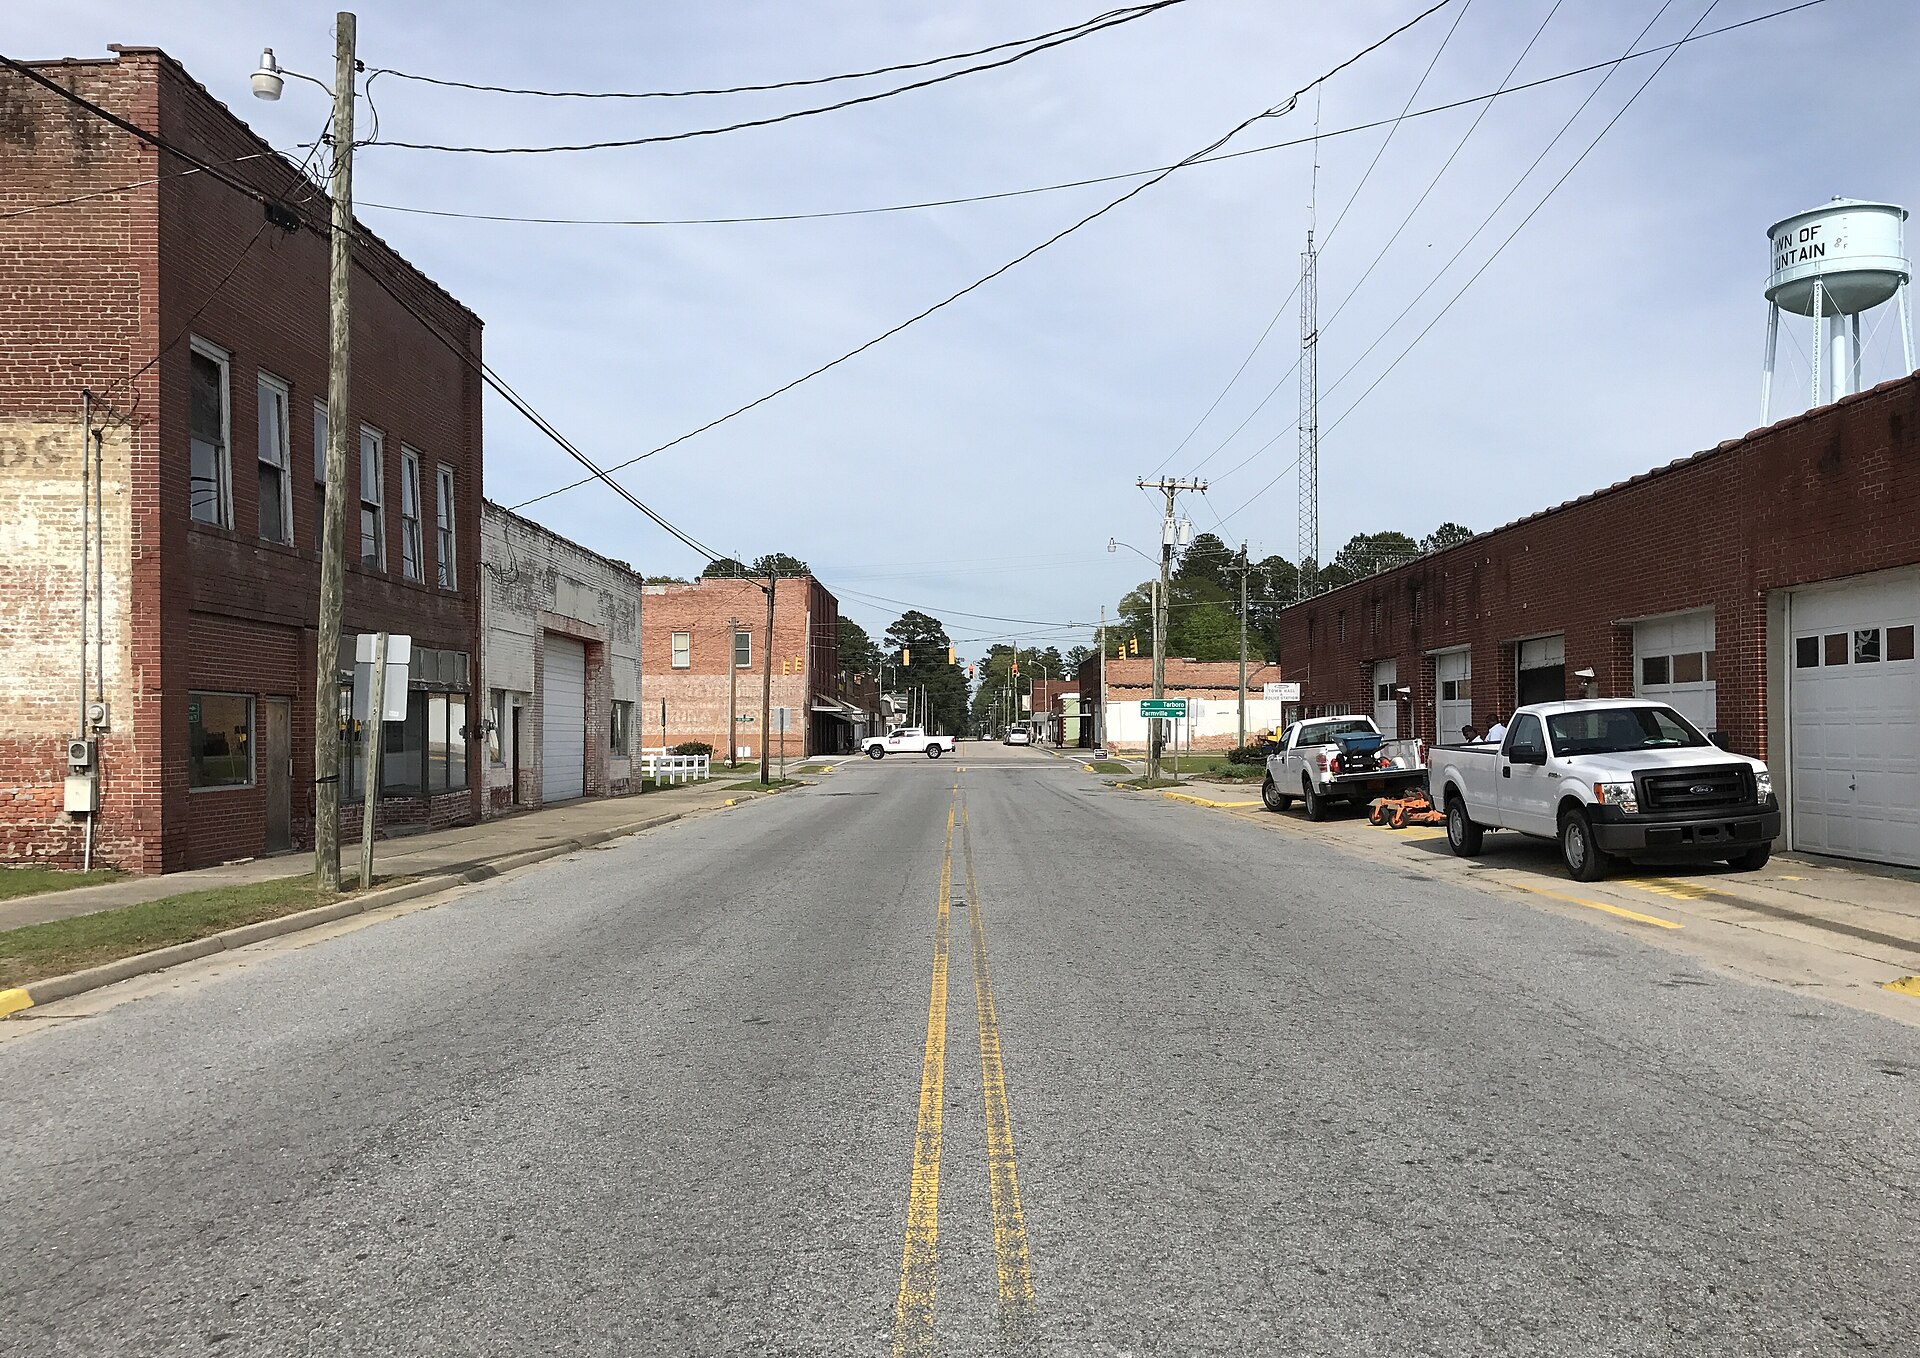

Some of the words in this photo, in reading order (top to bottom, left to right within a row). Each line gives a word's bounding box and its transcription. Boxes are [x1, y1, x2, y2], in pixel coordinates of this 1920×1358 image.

[1774, 233, 1793, 253] WN
[1799, 225, 1822, 243] OF
[1775, 242, 1825, 271] UNTAIN
